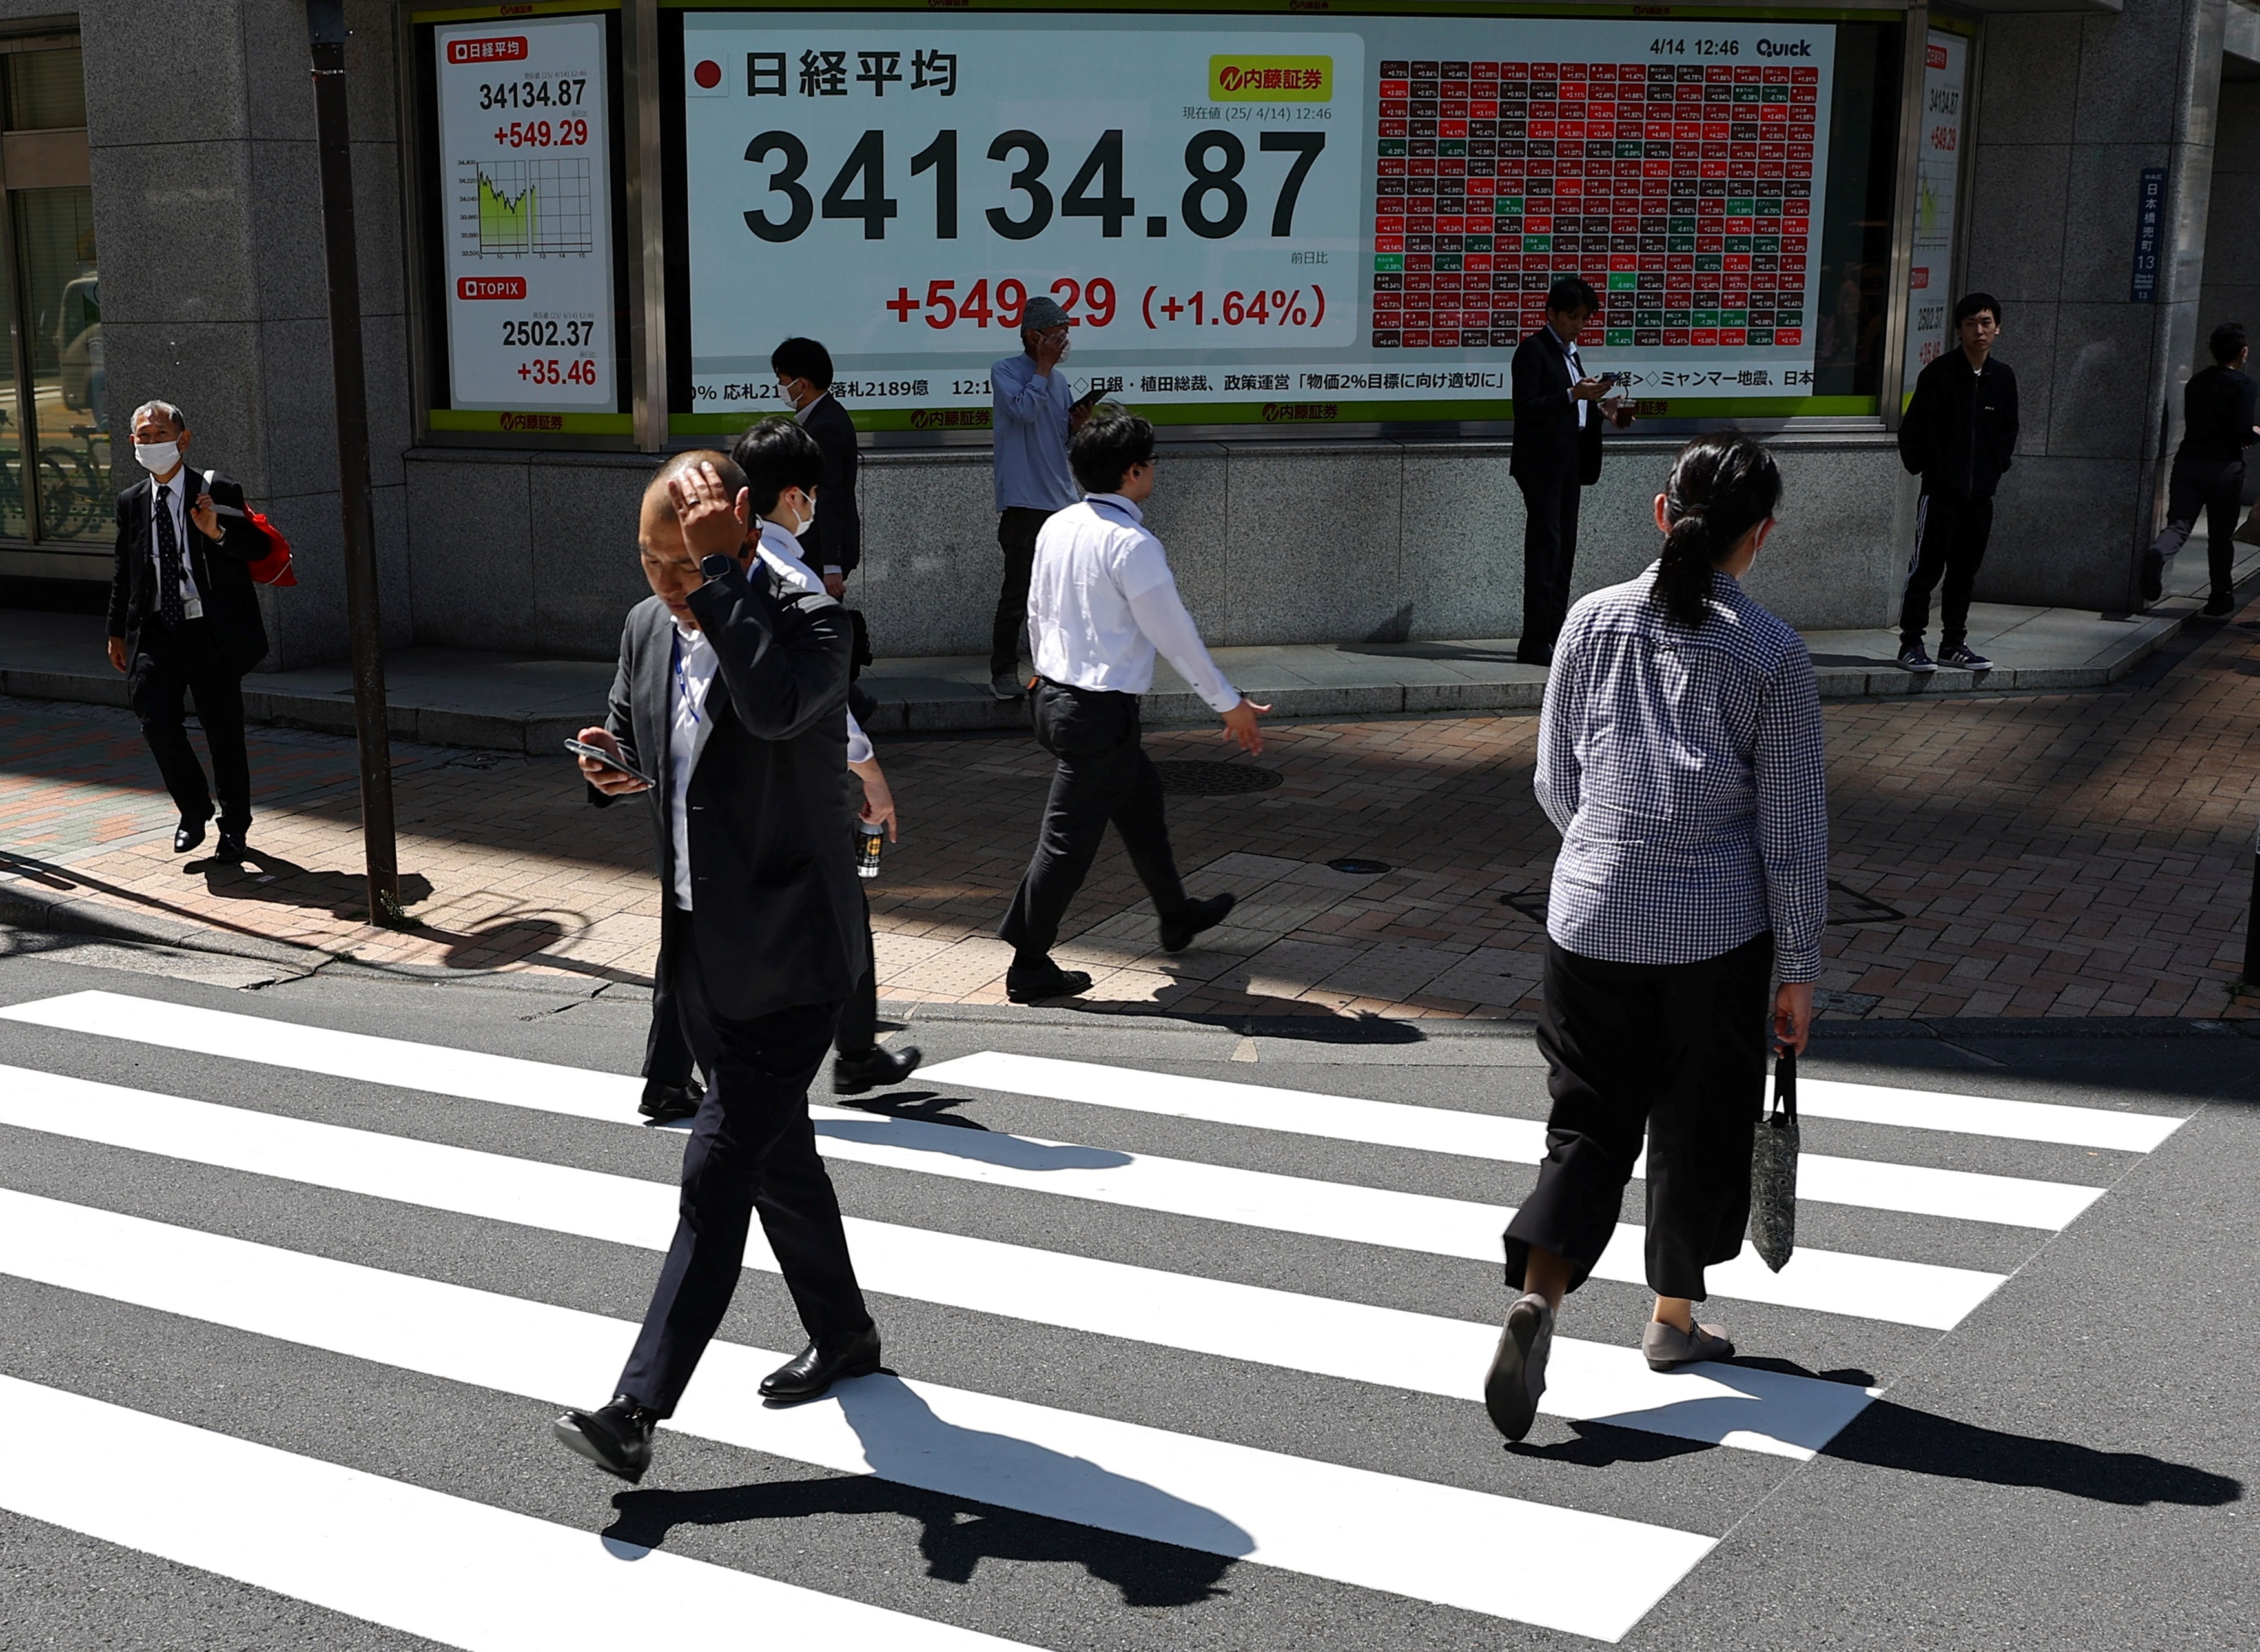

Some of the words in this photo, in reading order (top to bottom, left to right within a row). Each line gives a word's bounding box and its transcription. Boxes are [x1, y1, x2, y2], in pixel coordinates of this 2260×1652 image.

[470, 41, 520, 57] 日経平均
[1649, 39, 1685, 55] 4/14
[1694, 39, 1740, 56] 12:46
[1756, 39, 1812, 57] Quick
[746, 48, 958, 97] 日経平均
[1243, 68, 1322, 90] 内藤証券
[479, 79, 586, 110] 34134.87
[1182, 106, 1221, 120] 現在値
[1257, 107, 1291, 122] 4/14)
[1296, 107, 1332, 120] 12:46
[494, 119, 588, 148] +549.29
[743, 128, 1326, 241] 34134.87
[2141, 183, 2158, 251] 日本橋兜町
[1291, 251, 1328, 265] 前日比
[2138, 256, 2155, 269] 13
[478, 282, 519, 296] TOPIX
[885, 276, 1116, 329] +54929
[502, 320, 595, 346] 2502.37
[517, 359, 597, 385] +35.46
[929, 409, 991, 426] 内藤証券
[1280, 403, 1339, 420] 内藤証券
[515, 415, 563, 431] 内藤証券
